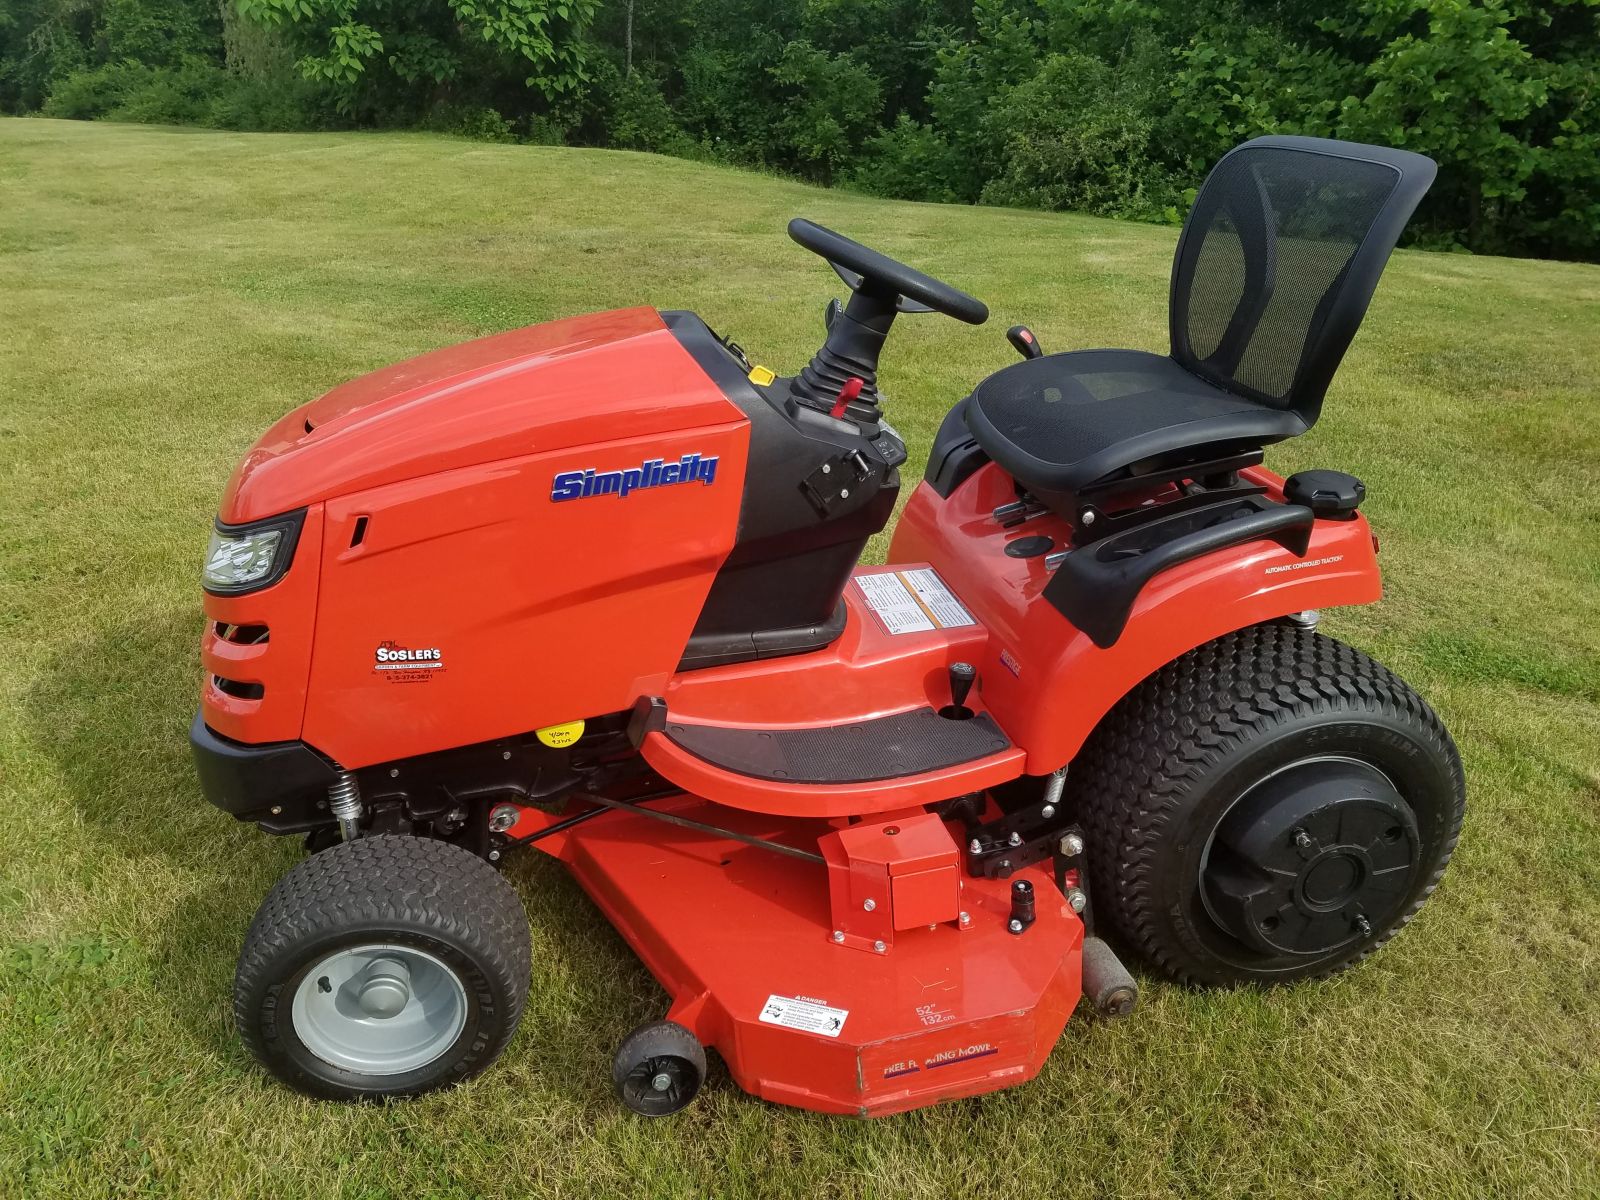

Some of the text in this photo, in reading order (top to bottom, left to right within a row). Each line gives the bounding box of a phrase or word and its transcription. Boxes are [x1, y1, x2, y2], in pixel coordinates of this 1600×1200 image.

[551, 453, 720, 502] Simplicity
[1264, 564, 1292, 575] AUTOMATIC
[1292, 560, 1320, 570] CONTROLLED
[376, 648, 441, 662] SOSLER'S
[801, 996, 828, 1006] DANGER
[958, 1043, 998, 1057] MOWE
